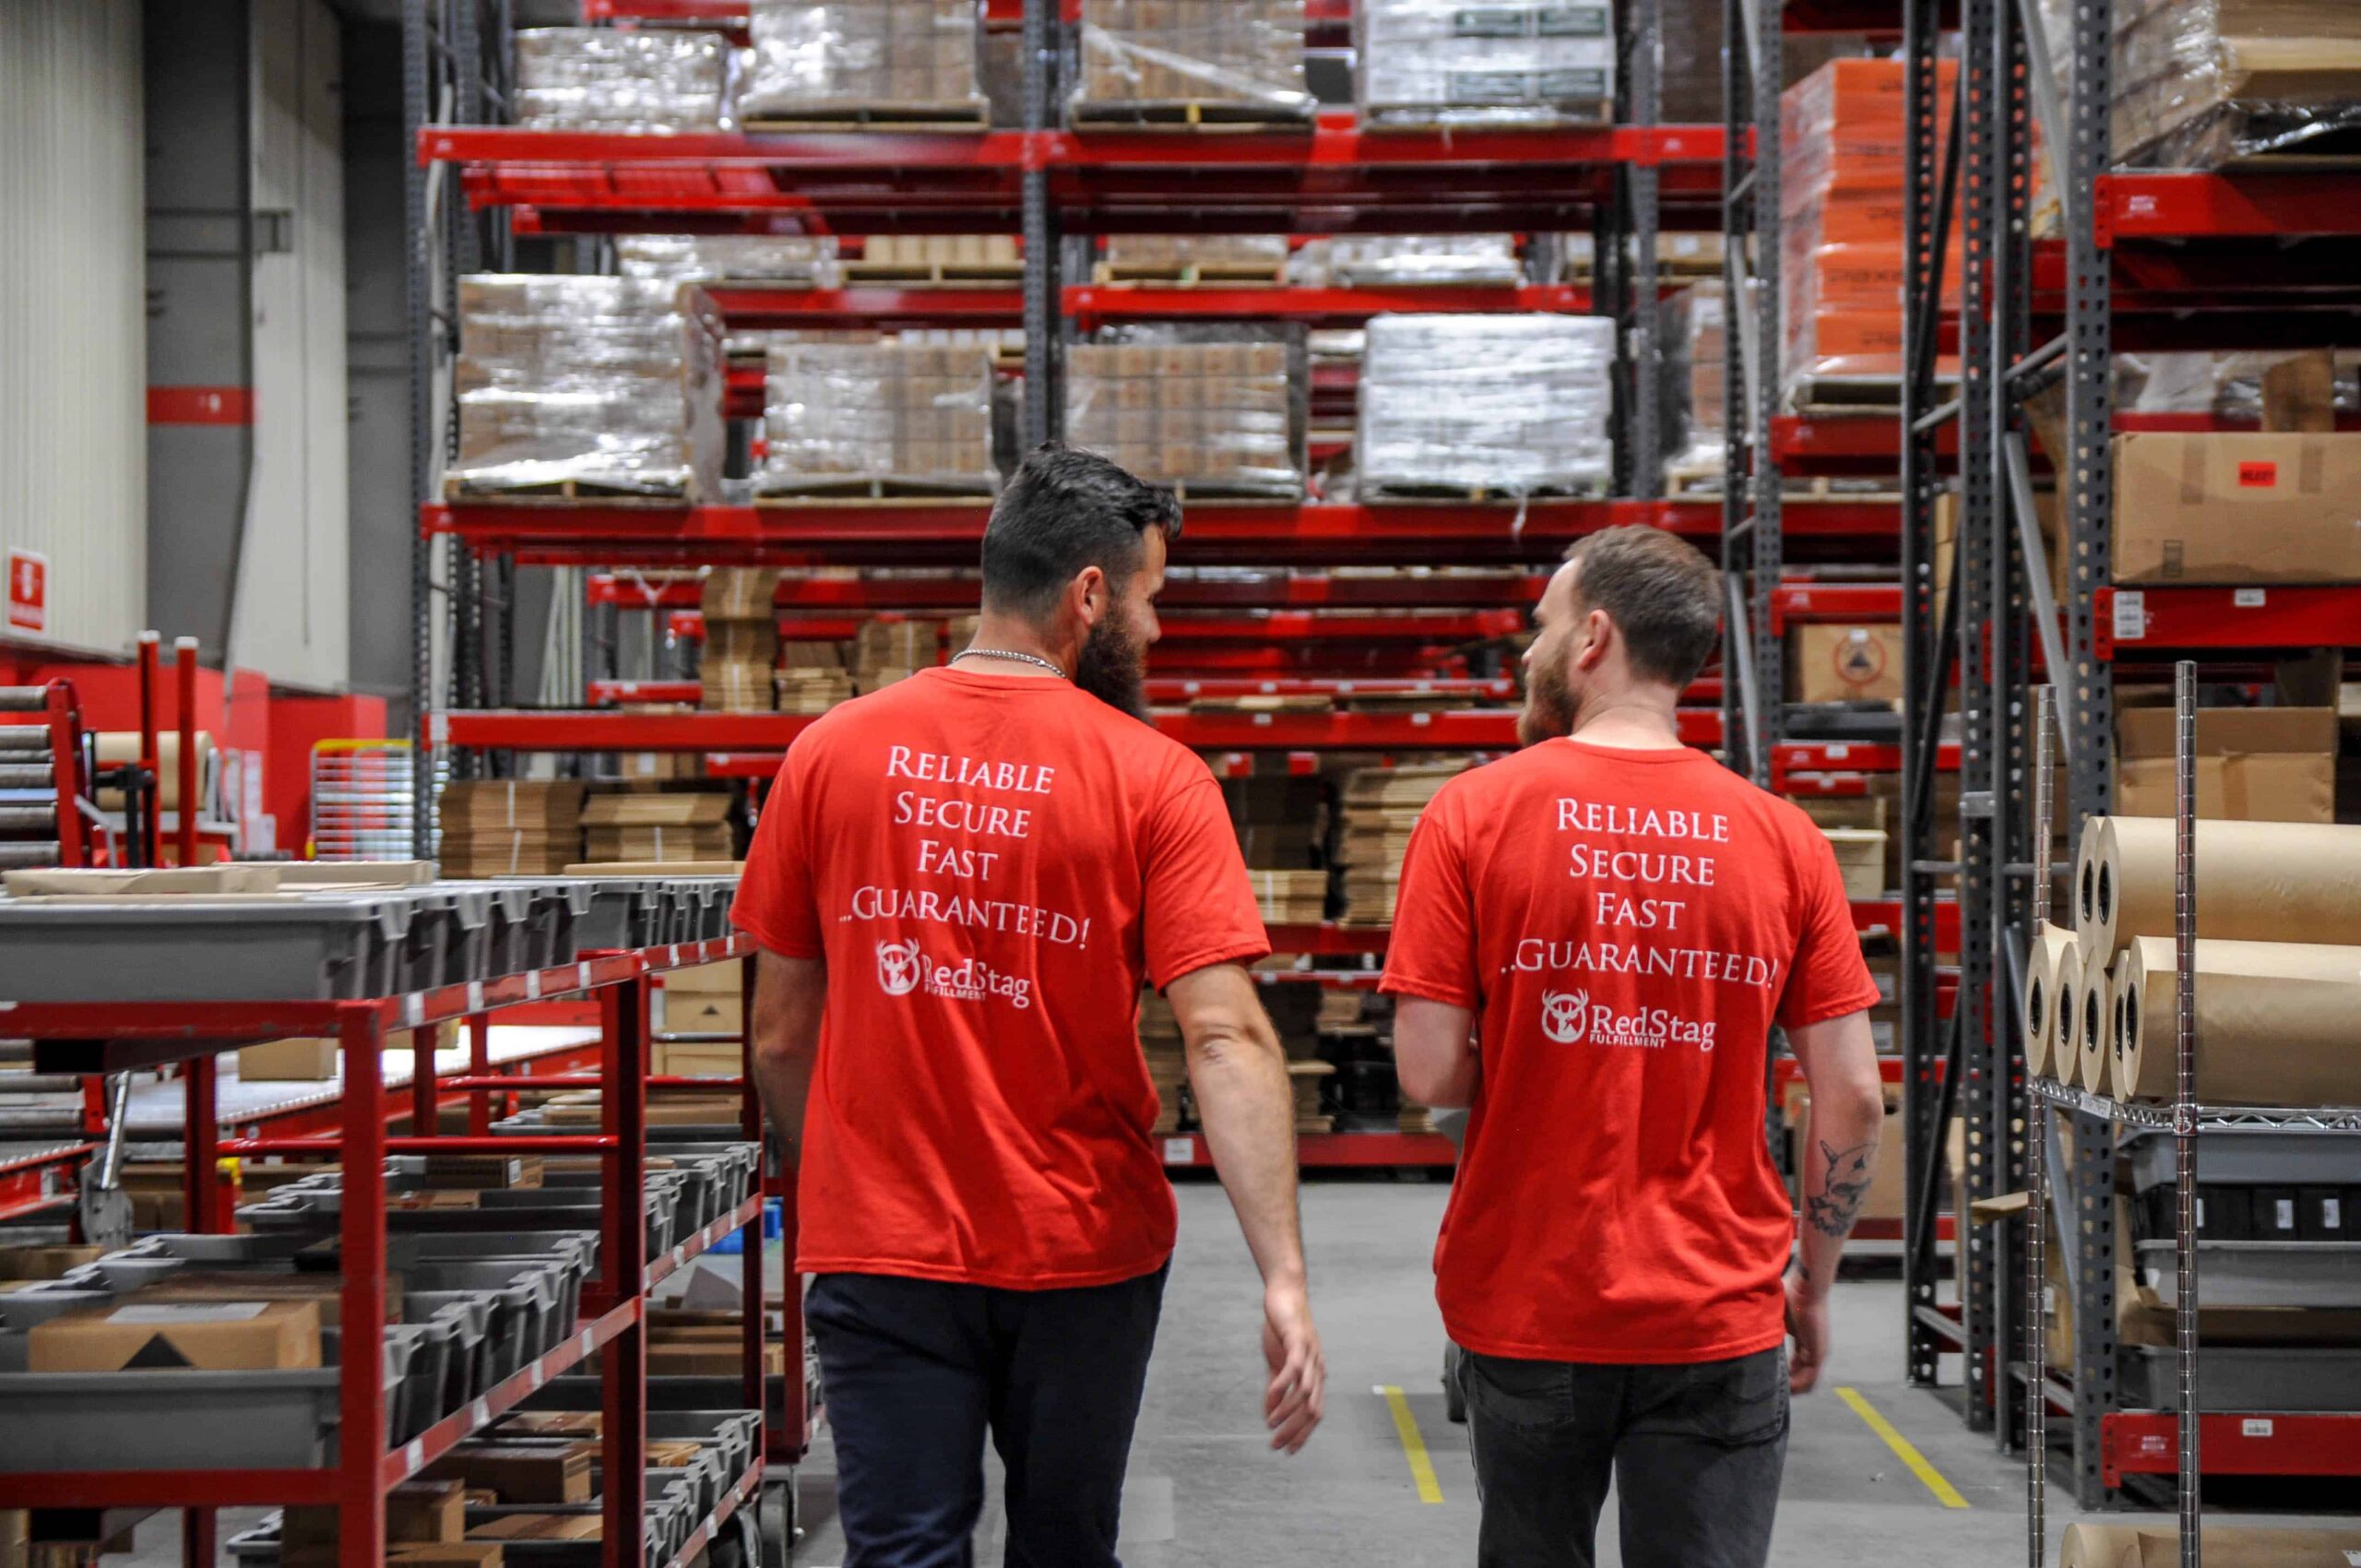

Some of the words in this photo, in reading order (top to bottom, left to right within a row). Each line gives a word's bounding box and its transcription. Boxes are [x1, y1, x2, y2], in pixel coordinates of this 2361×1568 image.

[886, 745, 1055, 794] RELIABLE
[895, 790, 1032, 838] SECURE
[1557, 798, 1730, 843] RELIABLE
[917, 839, 999, 881] FAST
[1570, 843, 1715, 886] SECURE
[1596, 892, 1686, 931] FAST
[921, 954, 1031, 1009] RedStag
[1589, 1033, 1667, 1049] FULFILLMENT
[1591, 1004, 1717, 1053] RedStag
